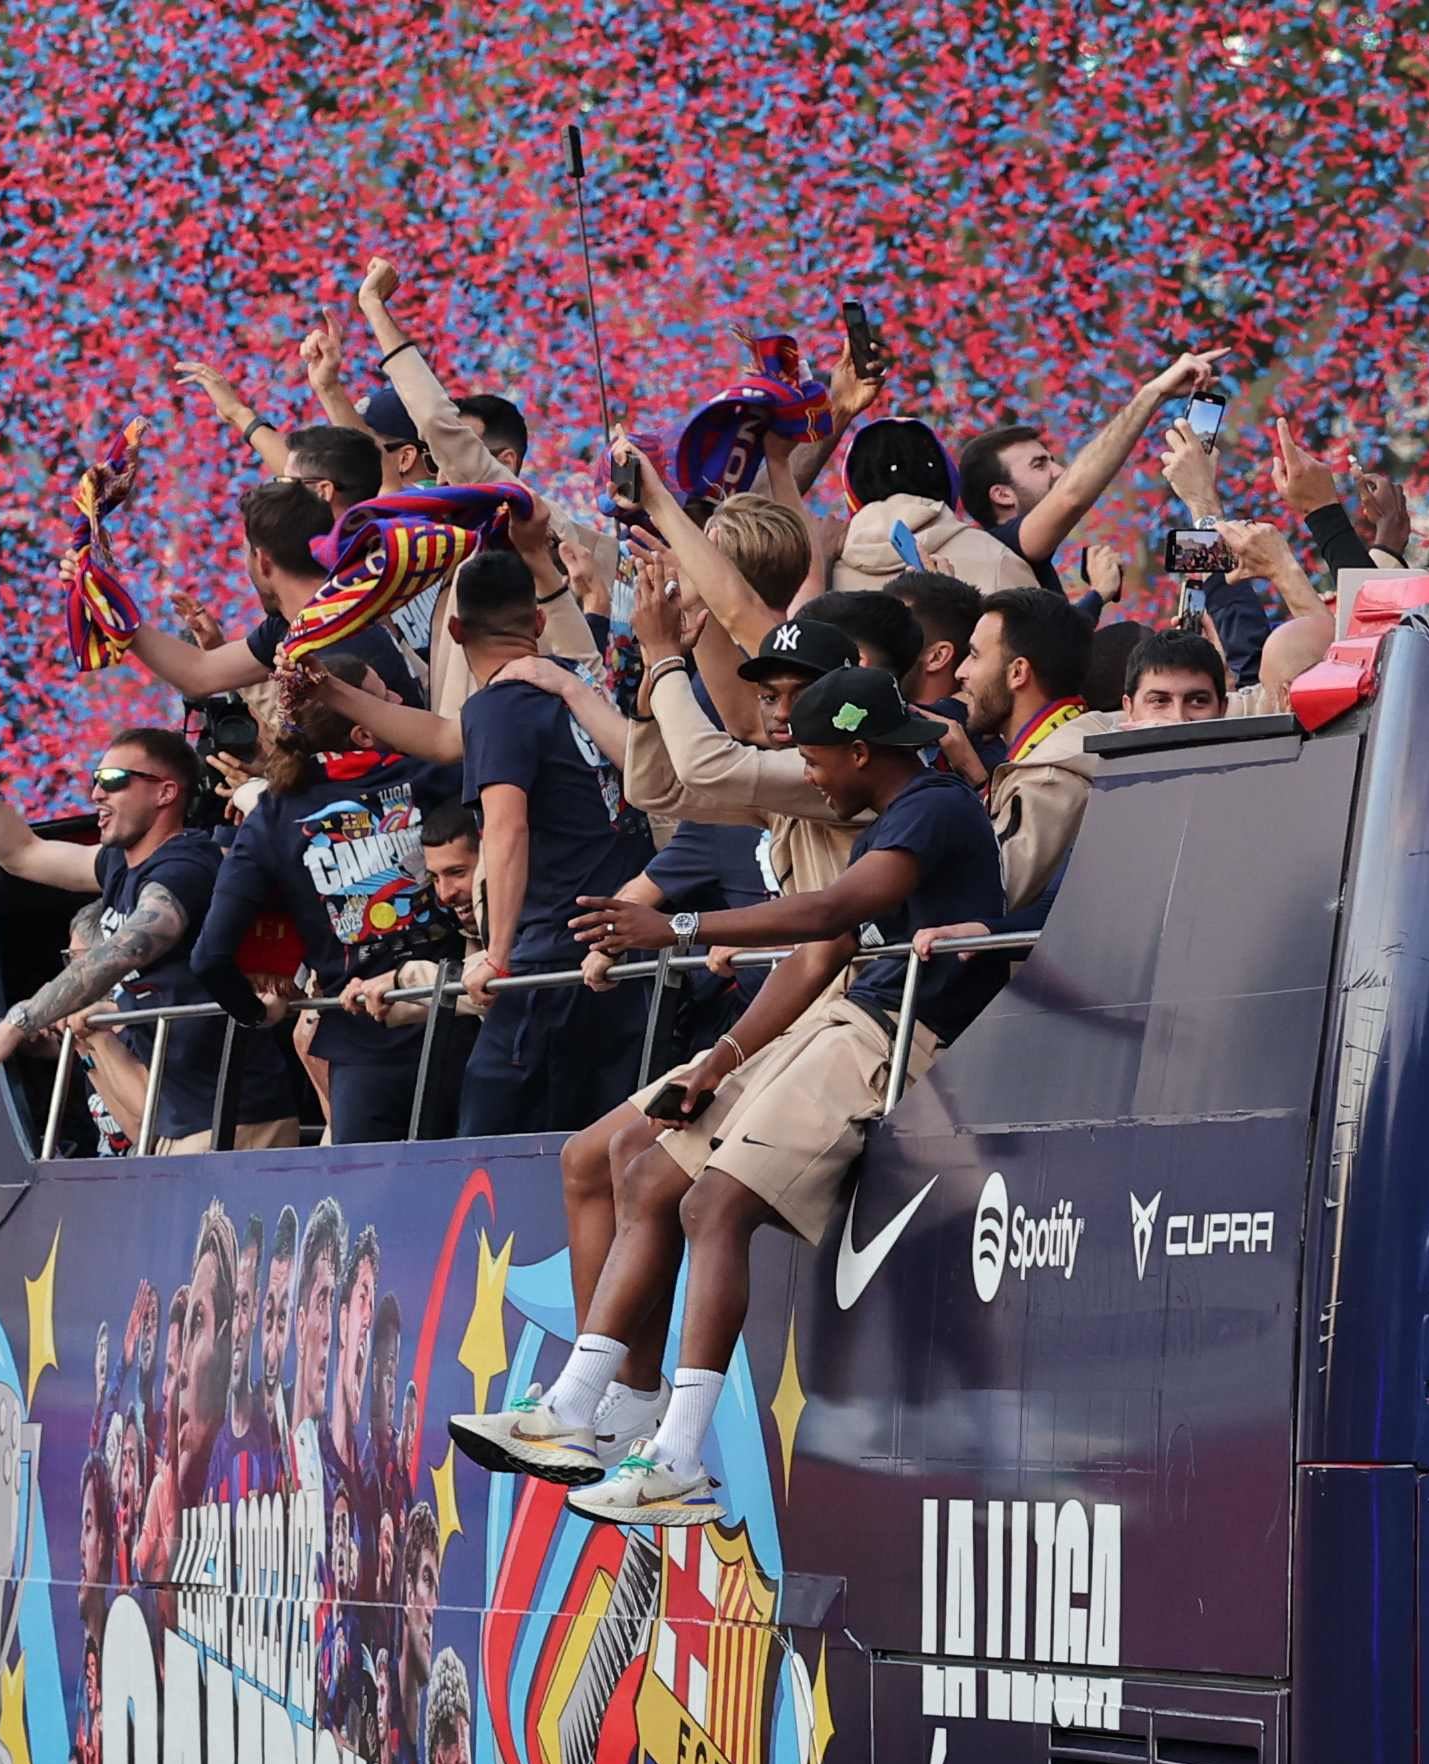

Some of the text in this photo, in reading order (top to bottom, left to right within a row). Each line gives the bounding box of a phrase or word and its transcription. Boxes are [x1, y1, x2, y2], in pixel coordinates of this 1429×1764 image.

[773, 624, 801, 650] NY
[377, 782, 412, 802] LLIGA
[1010, 1199, 1081, 1280] Spotify
[1165, 1211, 1274, 1256] CUPRA
[922, 1498, 1123, 1730] LA LLIGA
